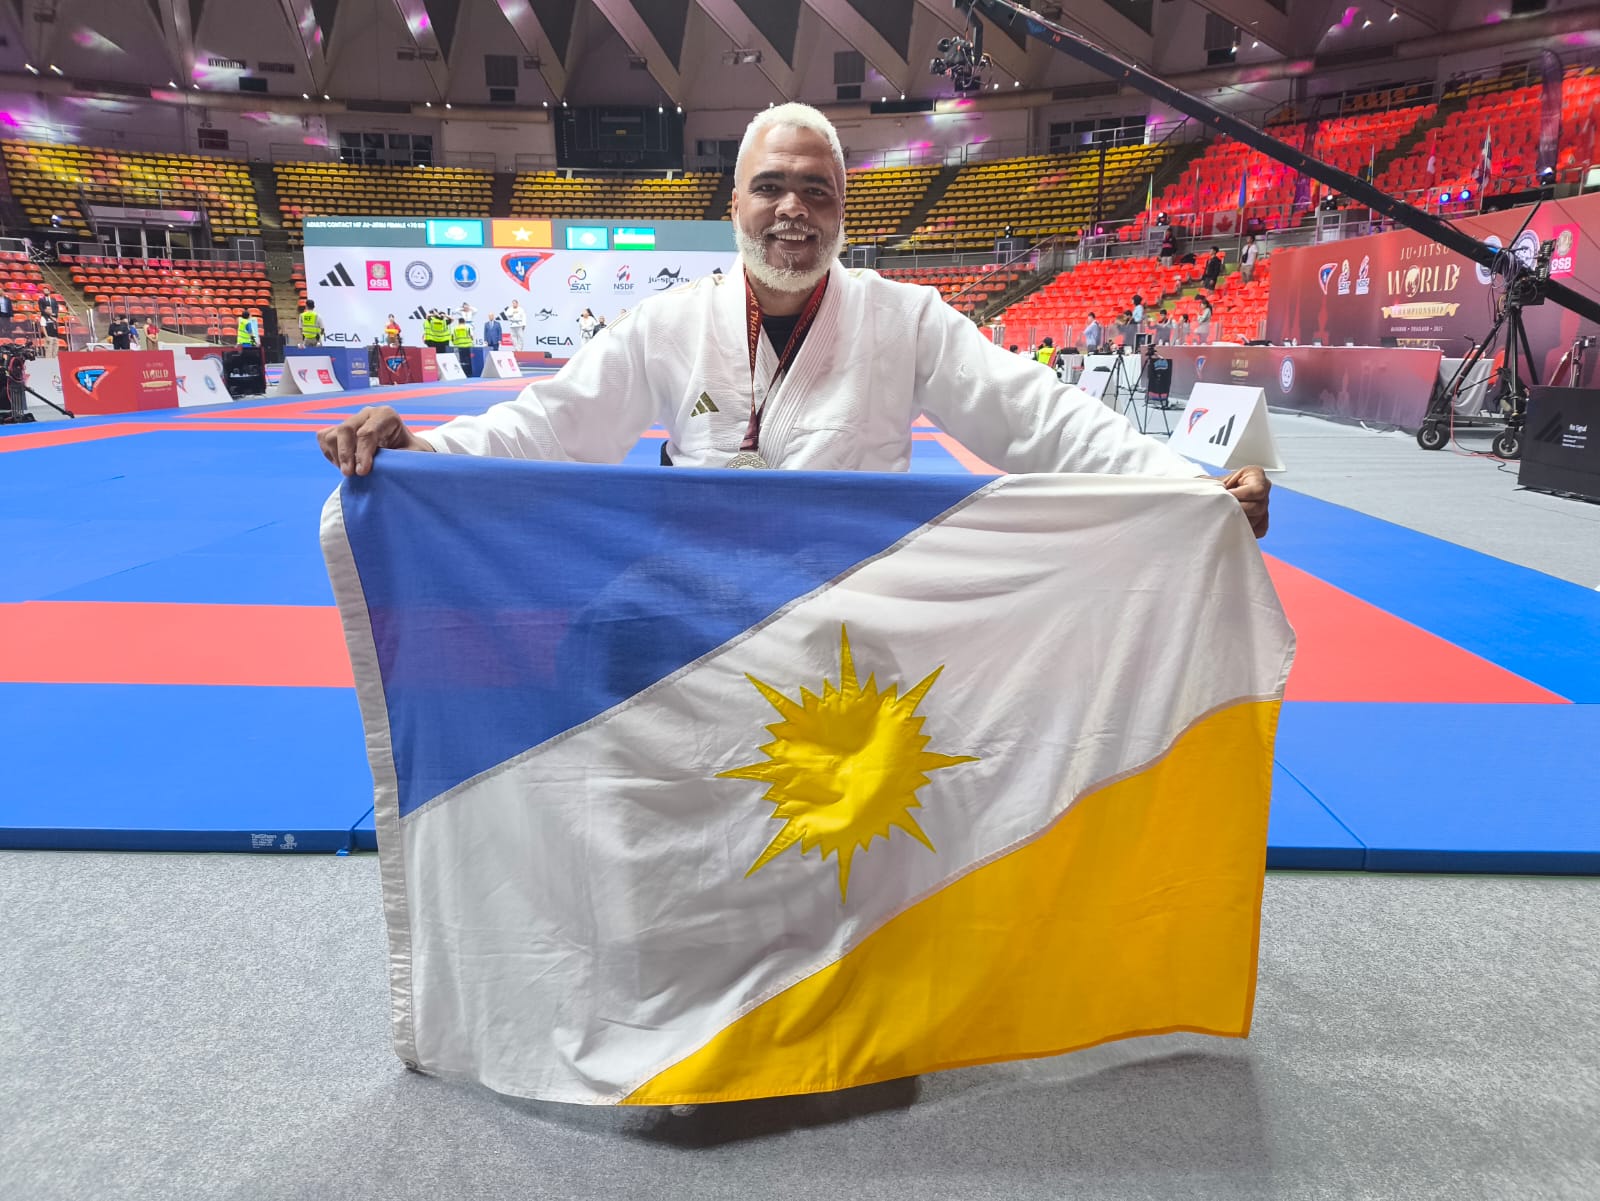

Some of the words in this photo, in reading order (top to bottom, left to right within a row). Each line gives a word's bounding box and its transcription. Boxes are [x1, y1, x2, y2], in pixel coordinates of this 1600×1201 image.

[1387, 263, 1461, 297] WORLD
[570, 283, 592, 291] SAT
[323, 332, 361, 342] KELA
[536, 336, 573, 345] KELA
